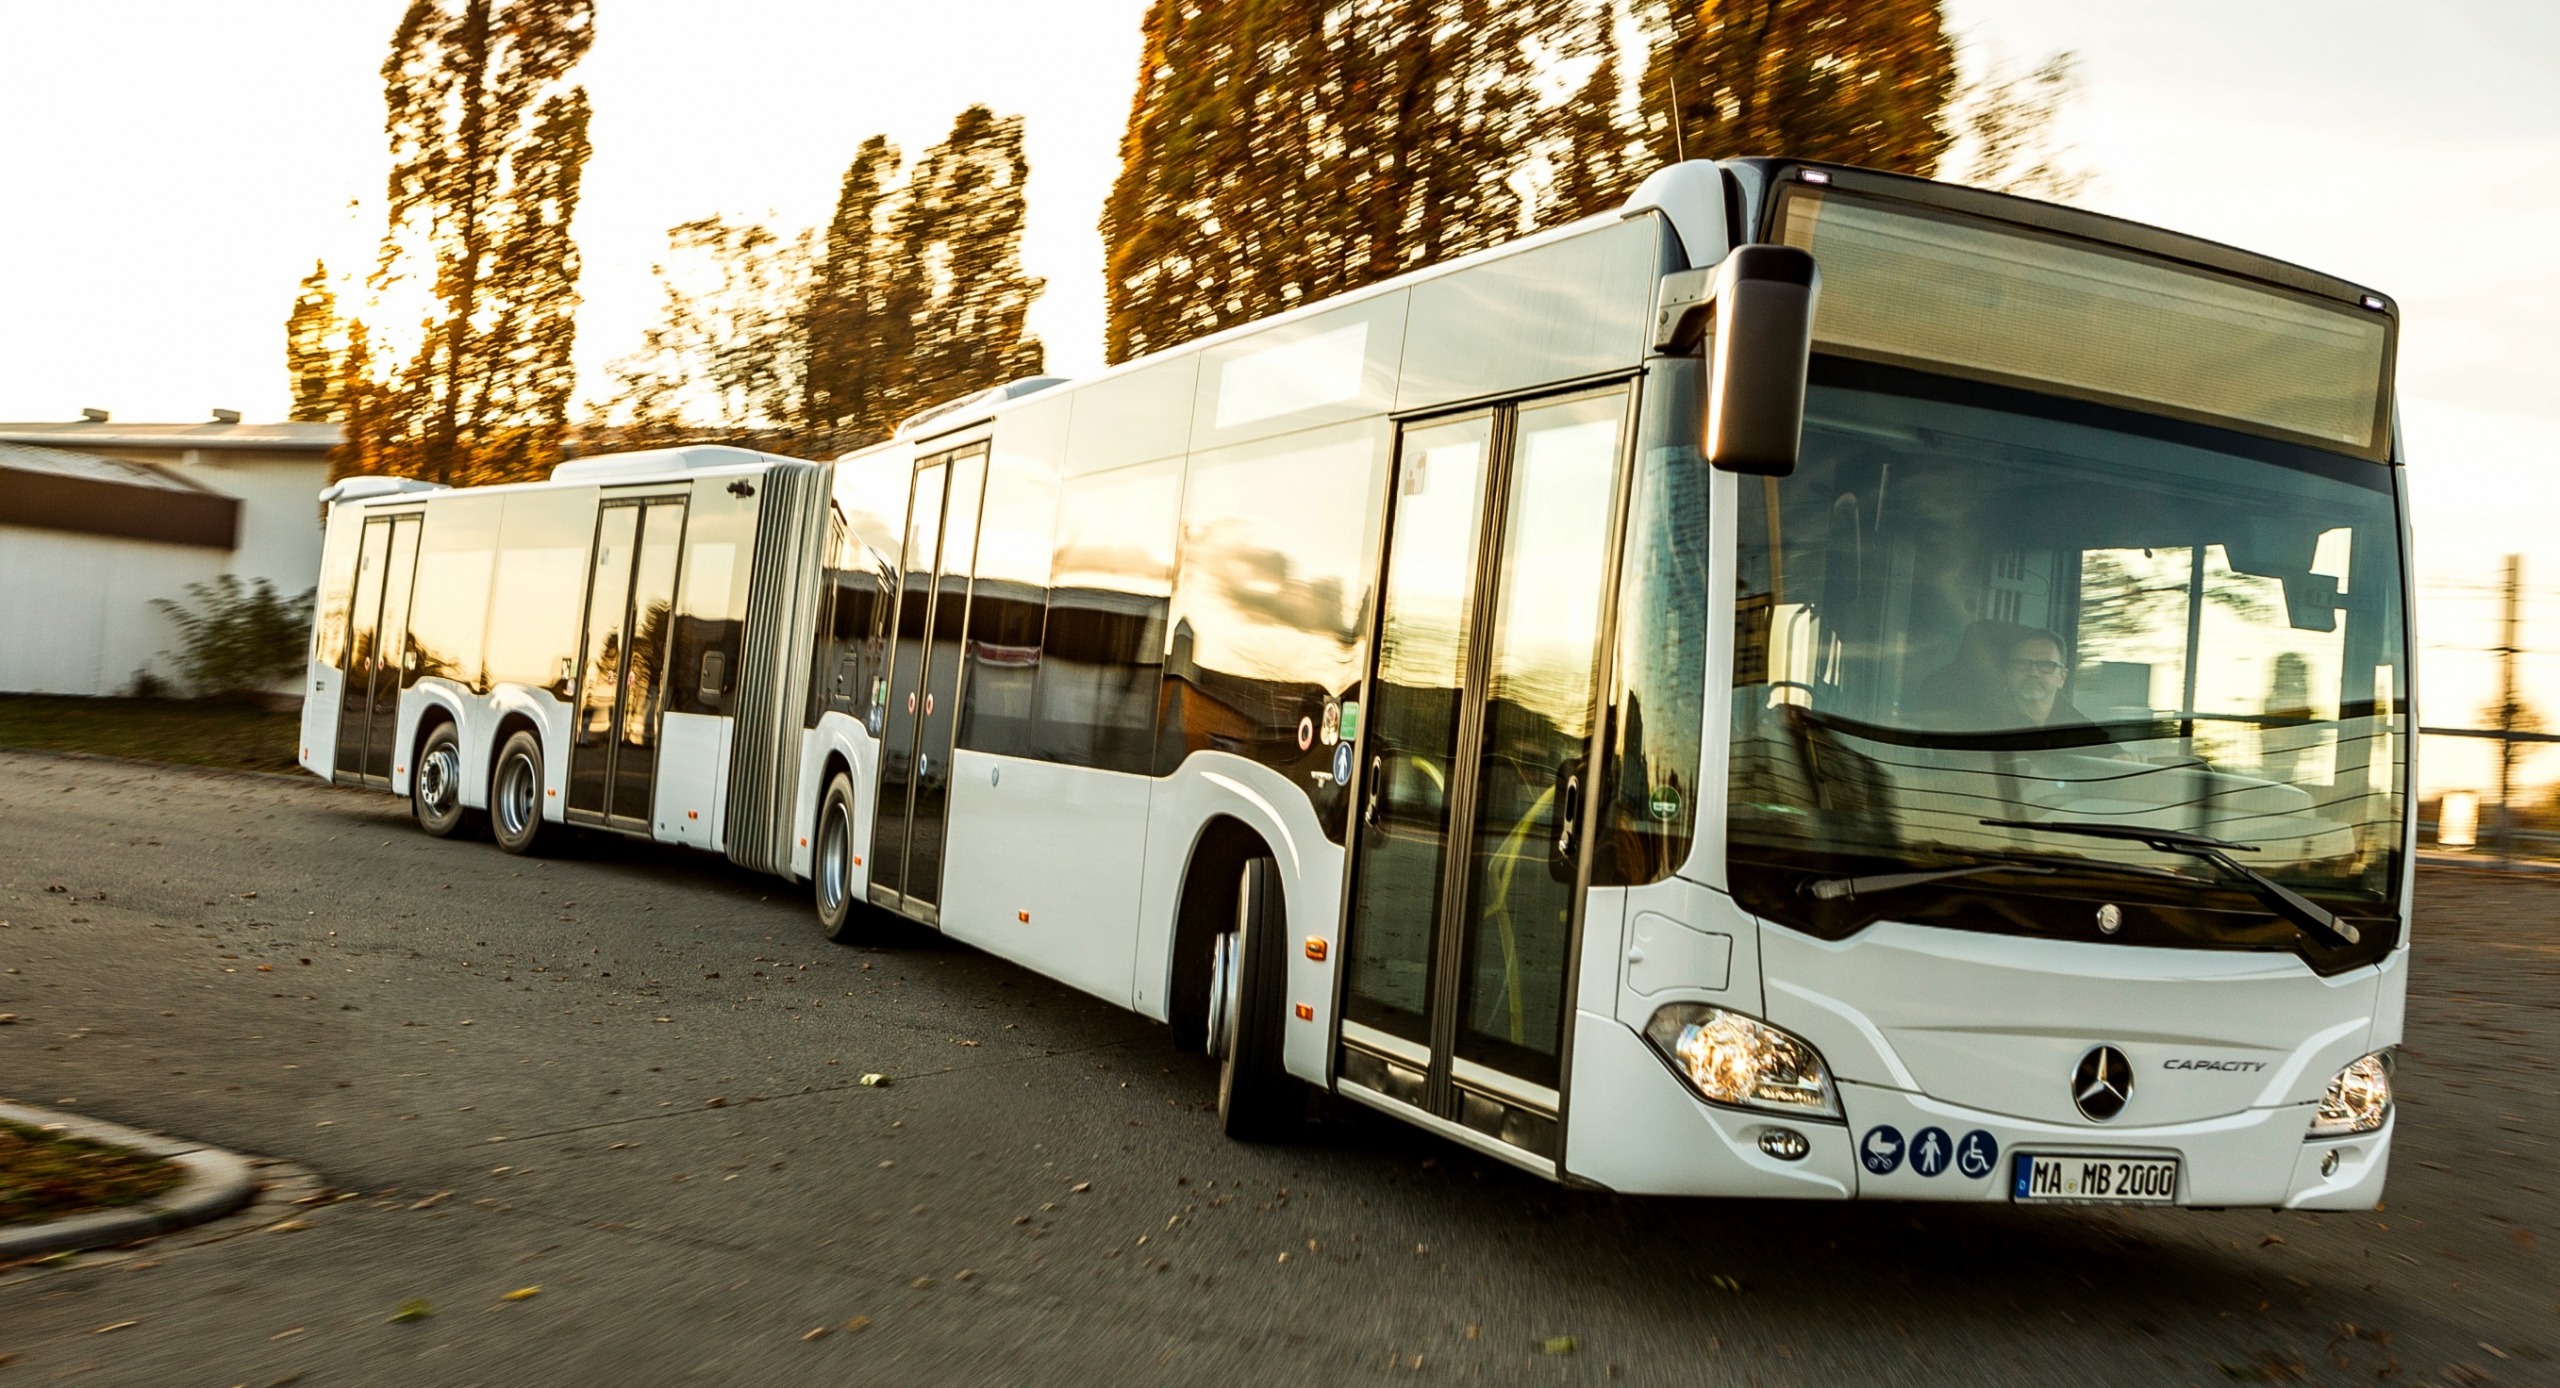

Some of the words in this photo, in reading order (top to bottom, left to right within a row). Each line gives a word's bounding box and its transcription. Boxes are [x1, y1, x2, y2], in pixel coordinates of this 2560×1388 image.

[2162, 1059, 2267, 1072] CAPACITY
[2032, 1161, 2061, 1194] MA
[2080, 1163, 2111, 1195] MB
[2115, 1164, 2173, 1196] 2000
